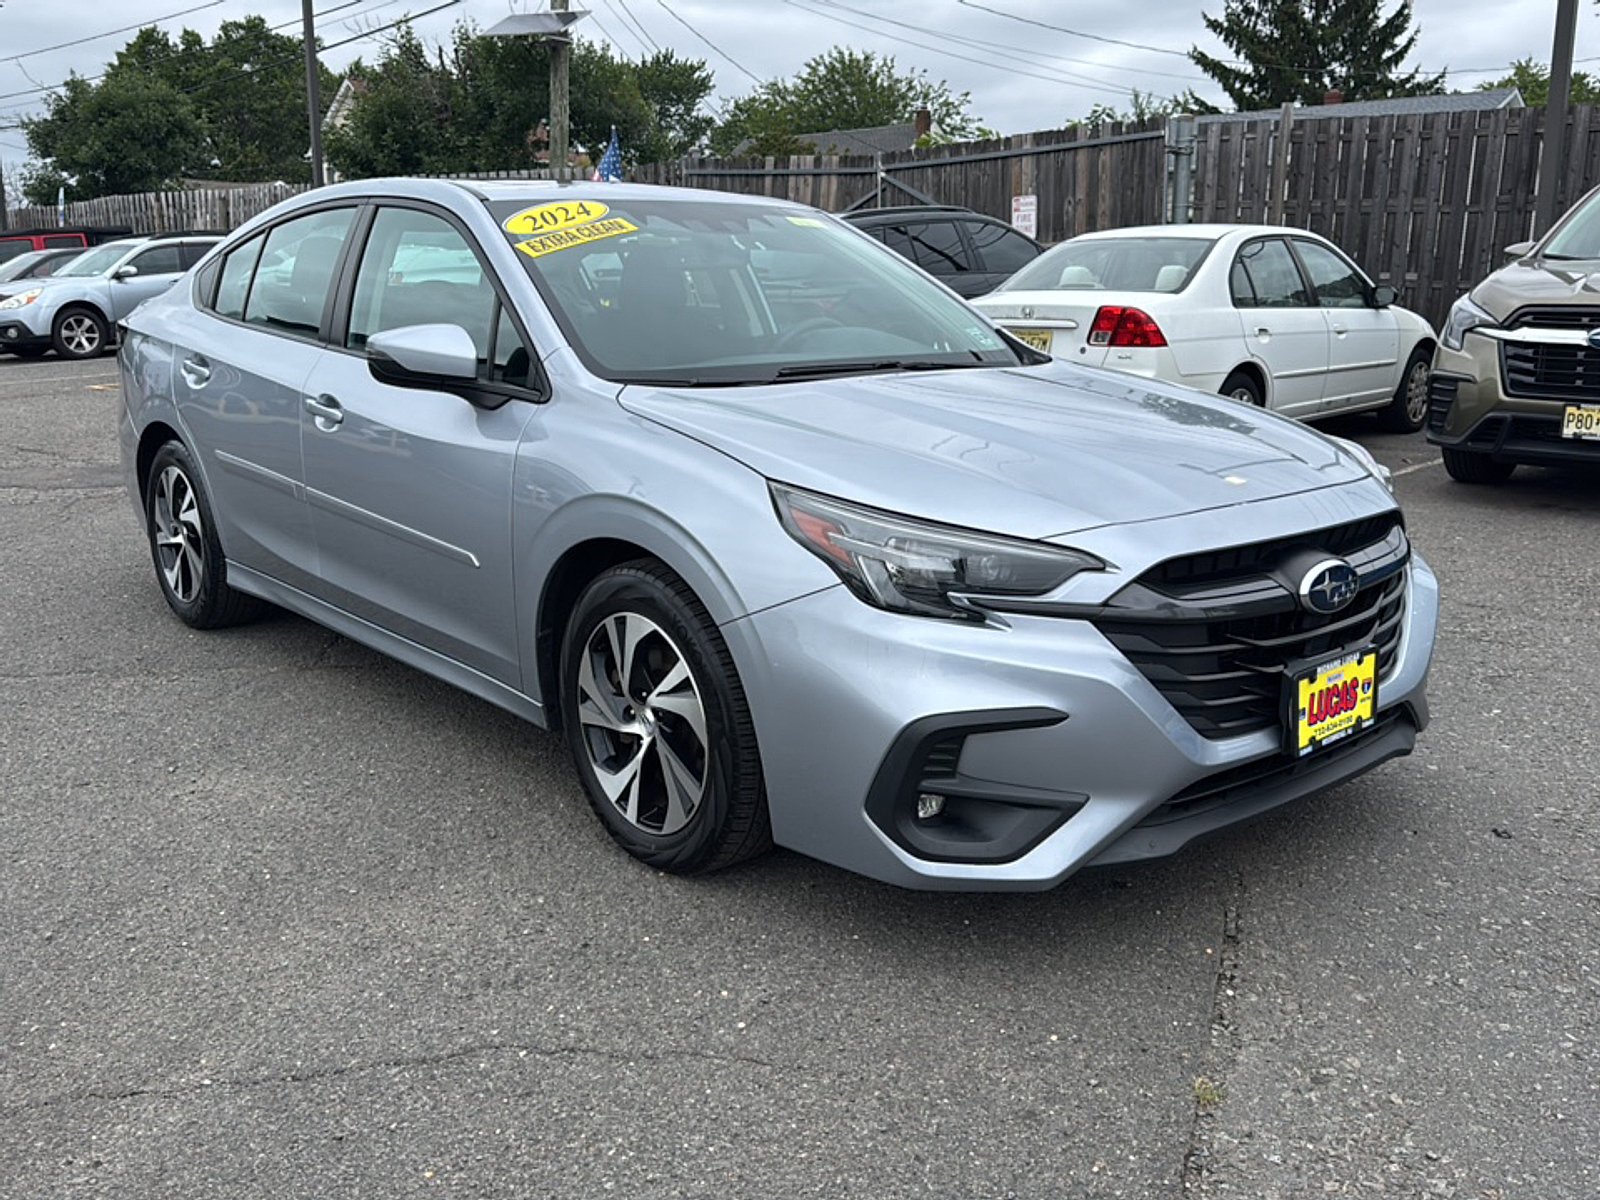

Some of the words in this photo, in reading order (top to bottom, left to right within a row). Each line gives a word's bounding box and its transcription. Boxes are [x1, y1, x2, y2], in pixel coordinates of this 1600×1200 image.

[523, 202, 591, 231] 2024
[526, 231, 580, 253] EXTRA
[576, 220, 628, 239] CLEAN
[1566, 412, 1592, 430] P80
[1308, 677, 1359, 726] LUCAS
